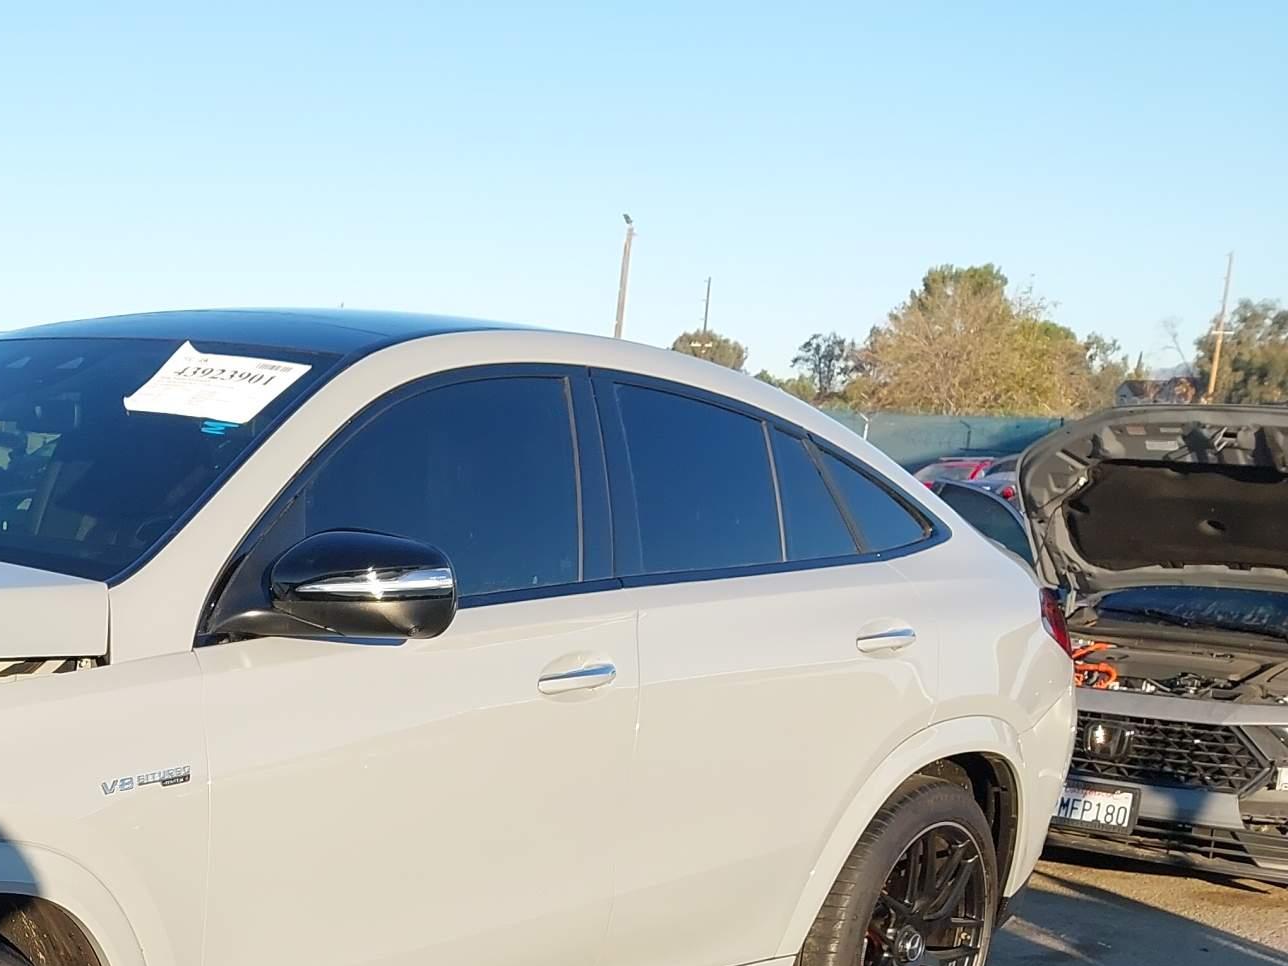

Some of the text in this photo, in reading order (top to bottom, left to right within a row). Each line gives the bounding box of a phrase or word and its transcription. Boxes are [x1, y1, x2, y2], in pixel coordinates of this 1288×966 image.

[174, 366, 277, 386] 43923901
[101, 776, 134, 795] V8
[1057, 796, 1128, 826] MFP180
